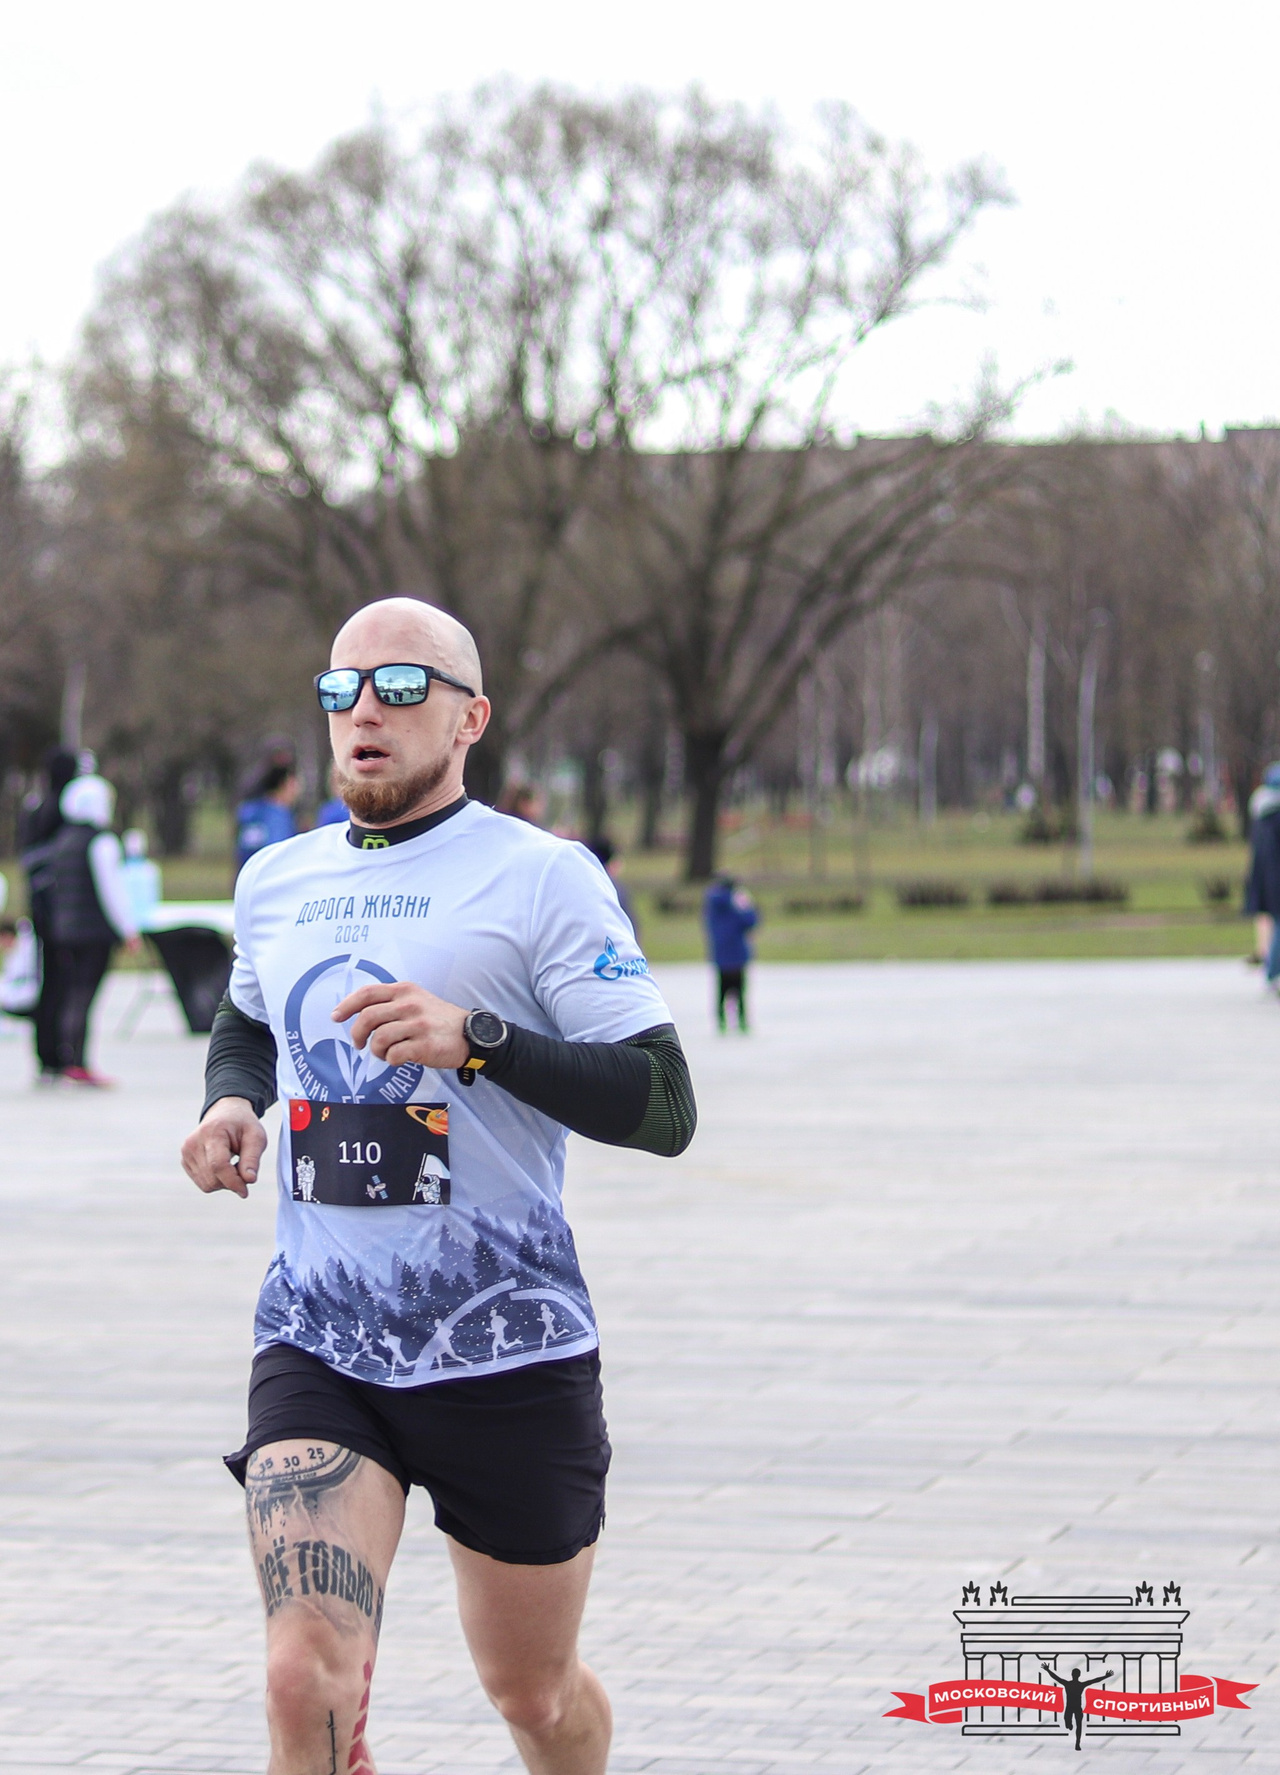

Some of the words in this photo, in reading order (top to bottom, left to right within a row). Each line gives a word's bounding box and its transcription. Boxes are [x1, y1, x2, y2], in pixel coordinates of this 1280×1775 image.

[295, 895, 355, 927] ДОРОГА
[361, 894, 431, 919] ЖИЗНИ
[334, 924, 369, 943] 2024
[286, 1030, 329, 1102] ЗИМНИЙ
[378, 1060, 421, 1104] МАРА
[338, 1140, 382, 1165] 110
[282, 1455, 300, 1469] 30
[306, 1447, 325, 1461] 25
[292, 1540, 373, 1618] ТОЛЬКО
